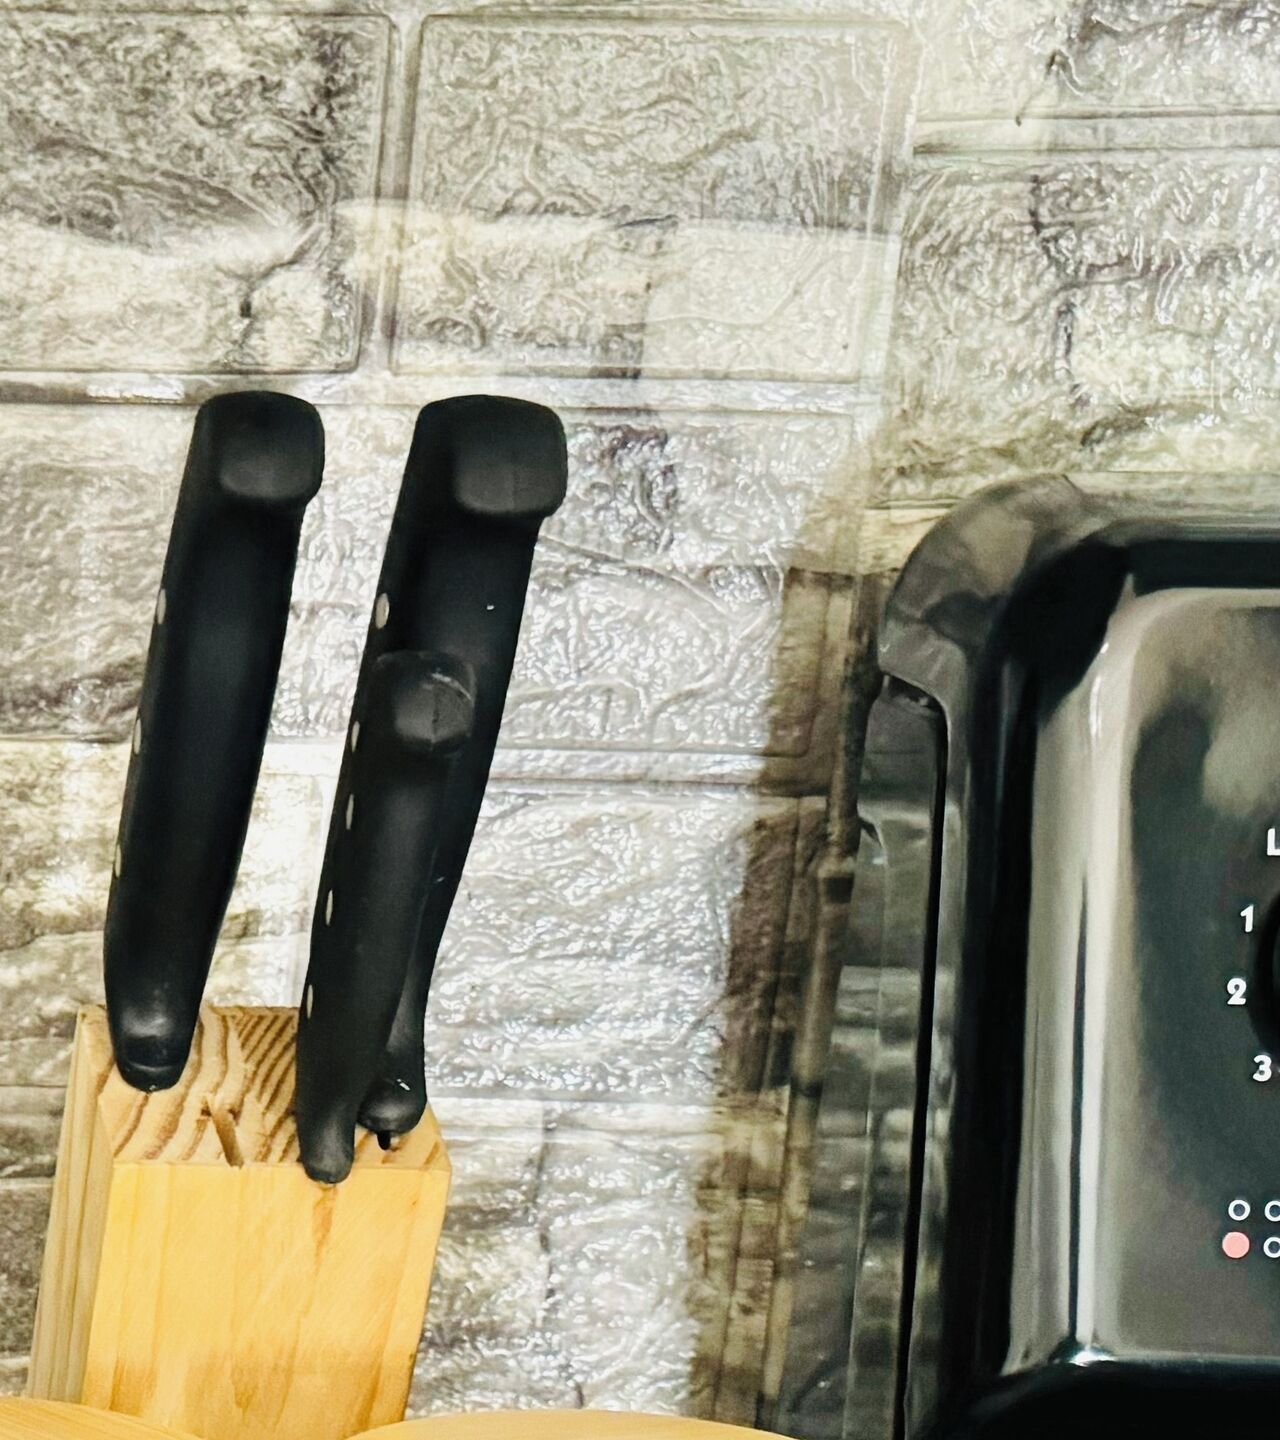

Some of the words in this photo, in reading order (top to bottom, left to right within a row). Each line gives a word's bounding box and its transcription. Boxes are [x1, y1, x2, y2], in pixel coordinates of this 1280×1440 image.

[1240, 904, 1255, 933] 1
[1227, 977, 1247, 1005] 2
[1252, 1054, 1272, 1082] 3
